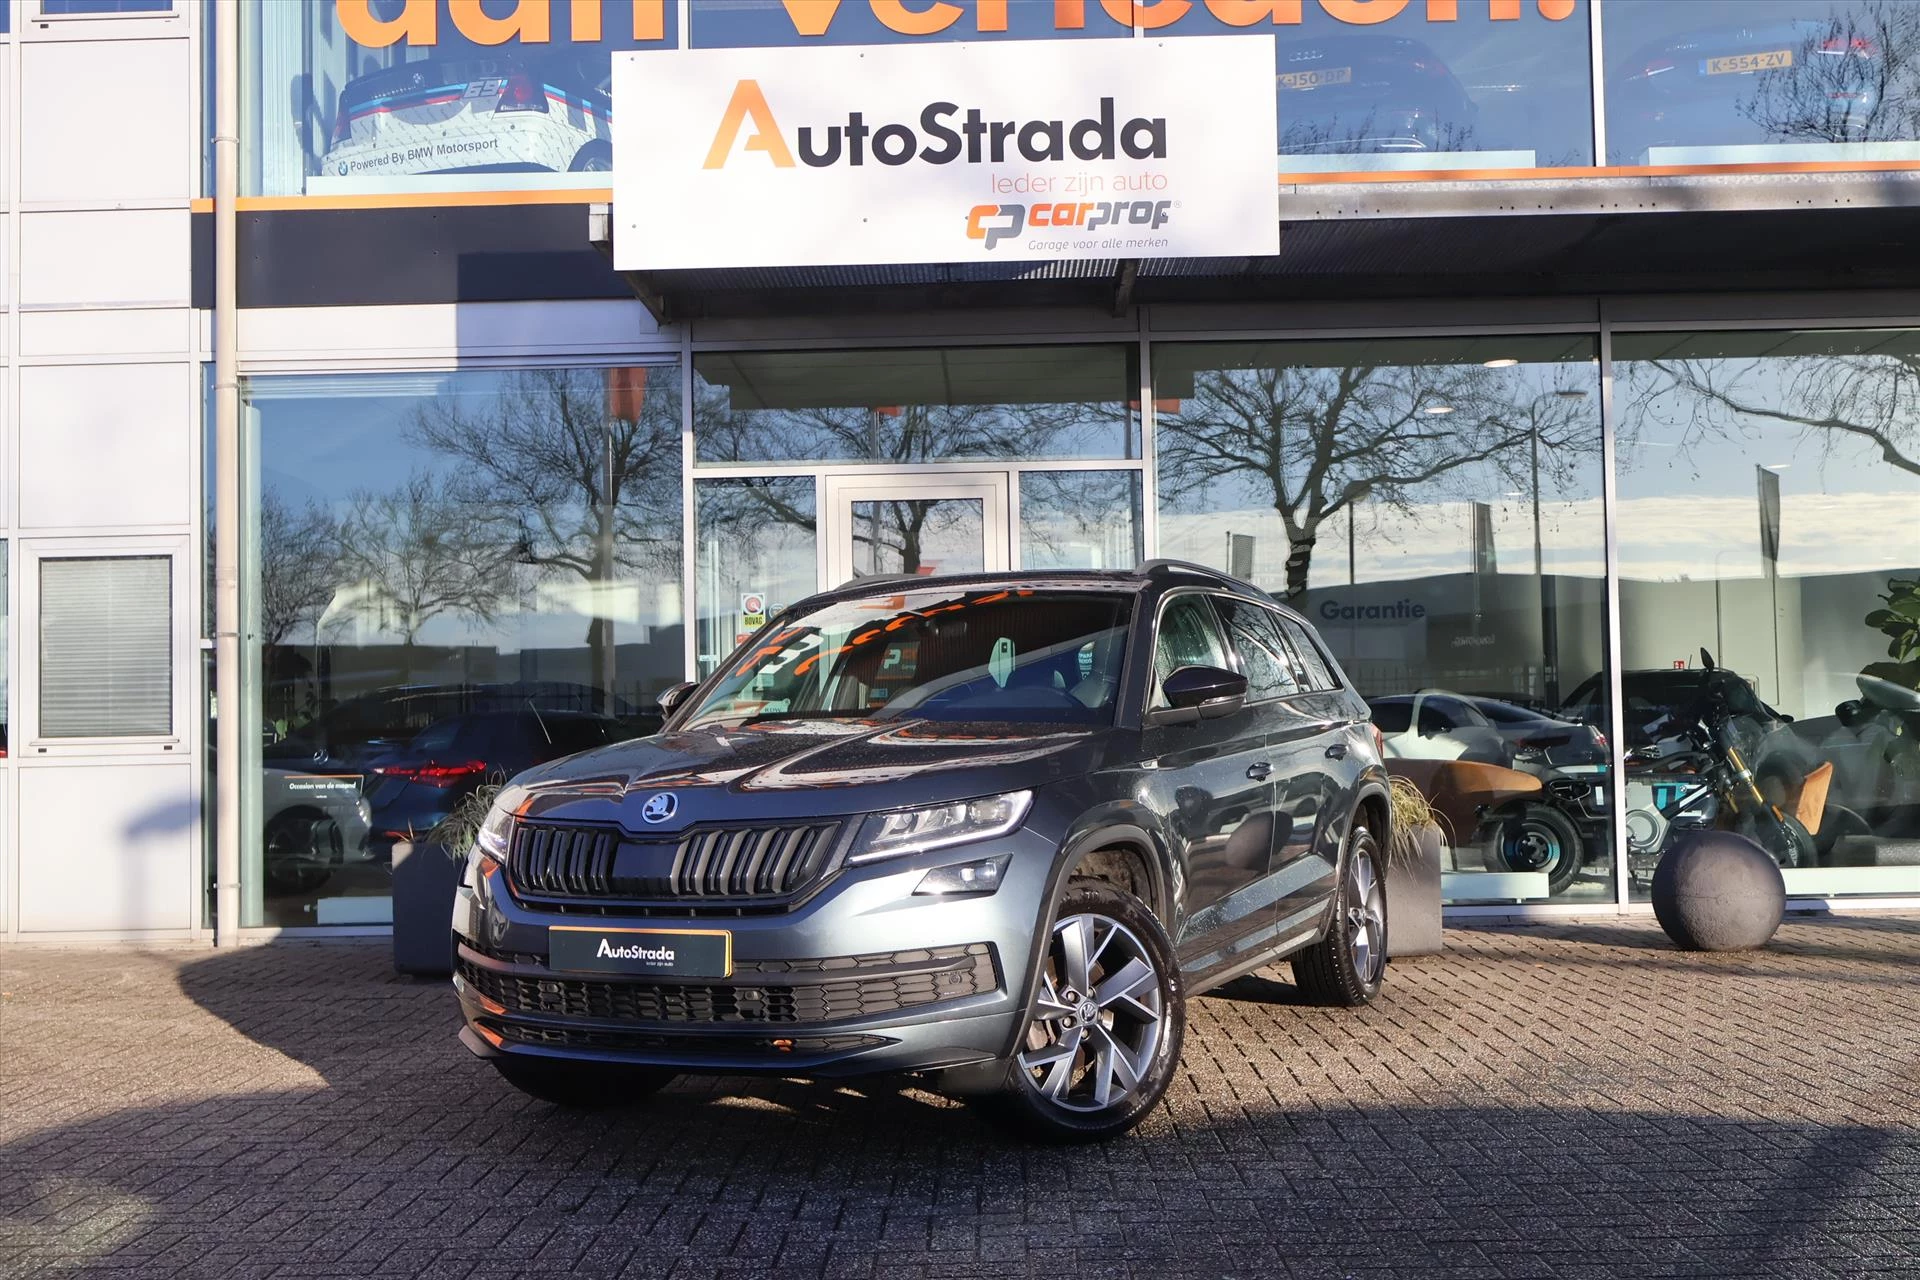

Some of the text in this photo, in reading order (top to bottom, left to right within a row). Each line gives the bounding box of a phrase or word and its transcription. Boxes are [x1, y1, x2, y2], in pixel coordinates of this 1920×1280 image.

[463, 79, 501, 99] 69
[702, 79, 1167, 169] AutoStrada
[350, 138, 499, 172] Powered By BMW Motorsport
[1064, 171, 1104, 197] zijn
[1112, 171, 1168, 191] auto
[1028, 236, 1169, 251] Garage voor alle merken
[1319, 598, 1426, 621] Garantie
[596, 938, 675, 961] AutoStrada
